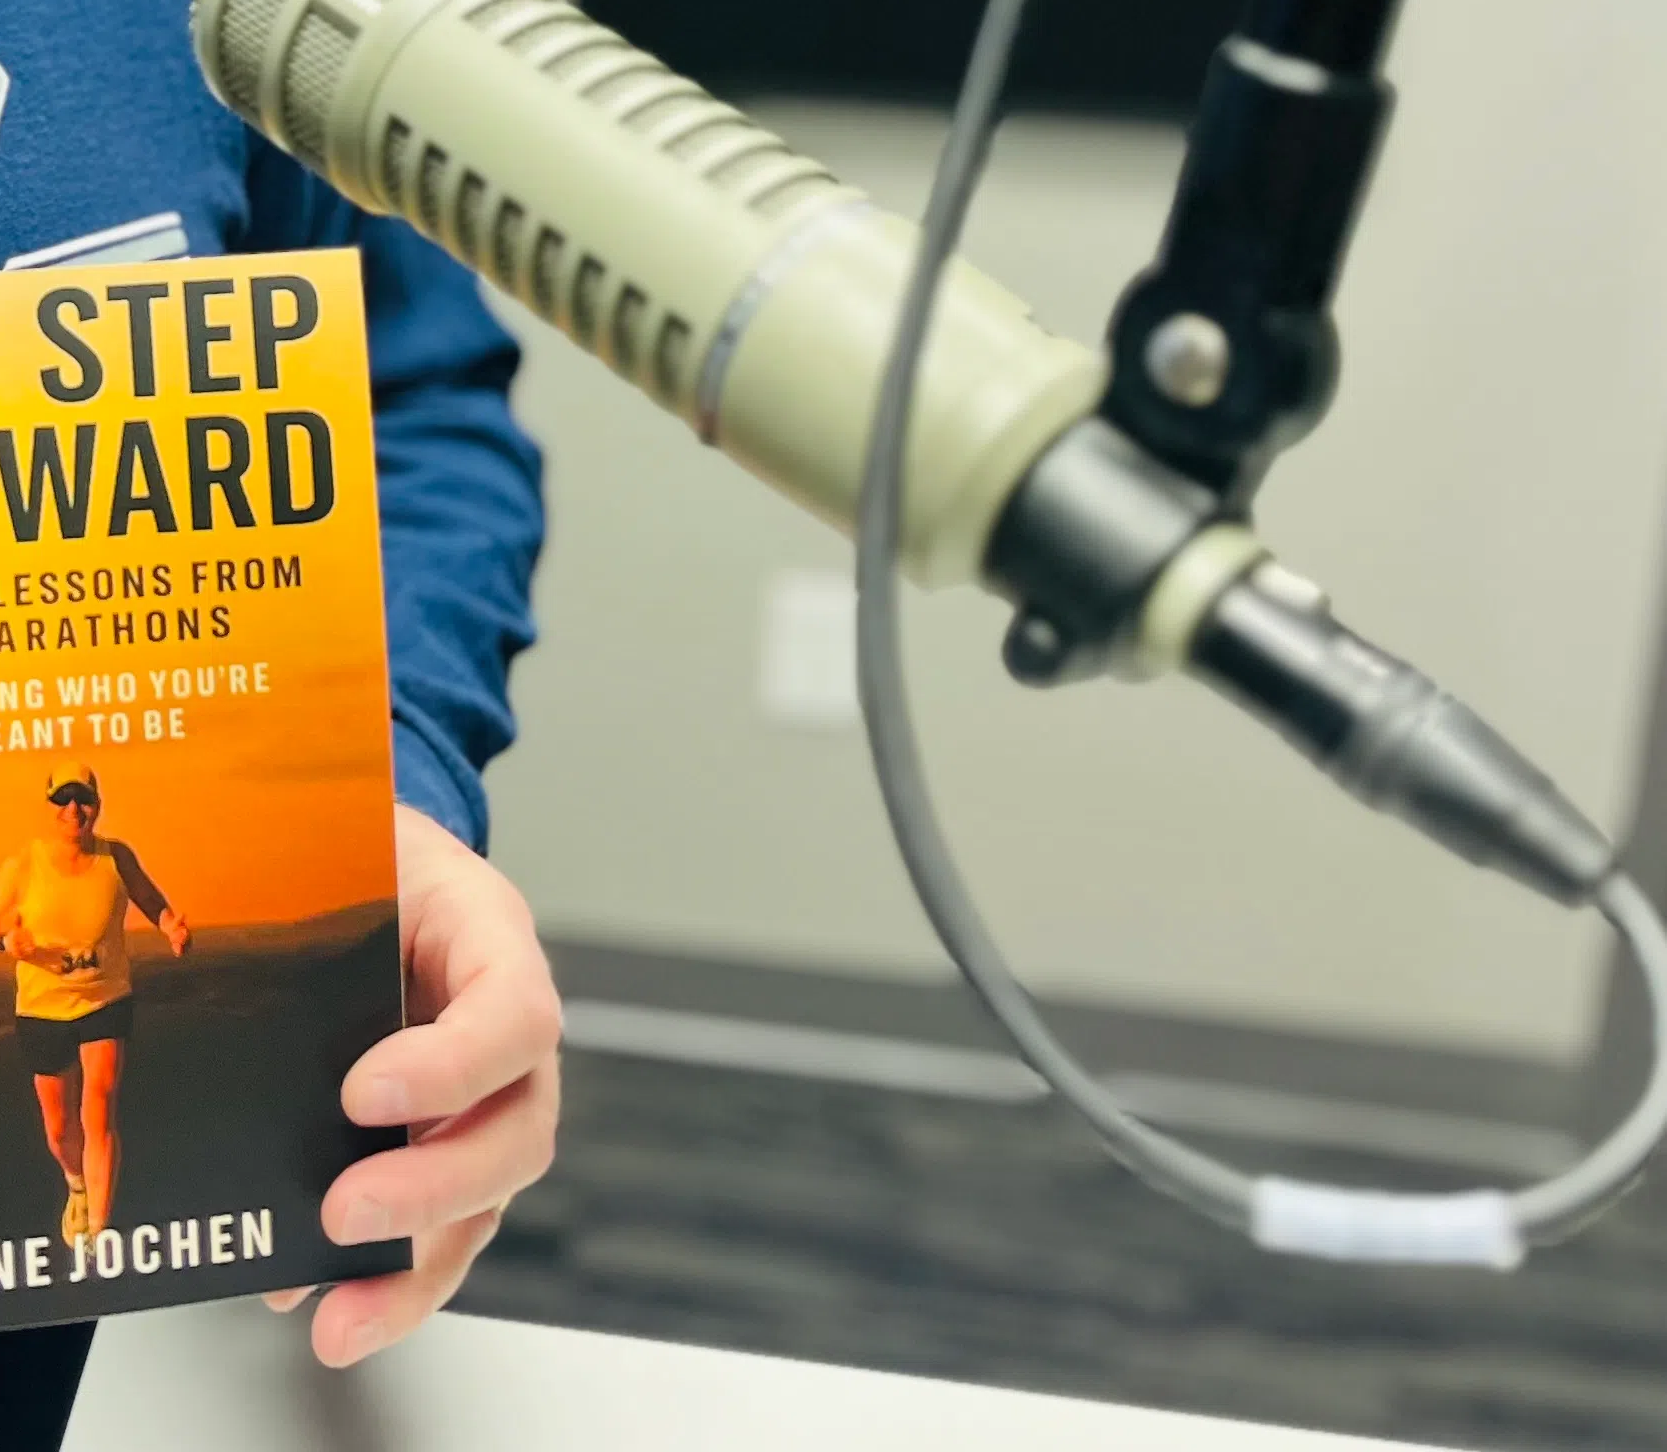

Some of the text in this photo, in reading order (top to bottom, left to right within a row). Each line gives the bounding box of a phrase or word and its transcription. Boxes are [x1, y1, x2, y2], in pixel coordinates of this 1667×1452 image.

[35, 275, 319, 403] STEP
[192, 555, 302, 594] FROM
[56, 672, 137, 707] WHO
[149, 662, 270, 700] YOU'RE
[87, 712, 130, 745] TO
[143, 708, 186, 741] BE
[69, 1208, 273, 1283] JOCHEN
